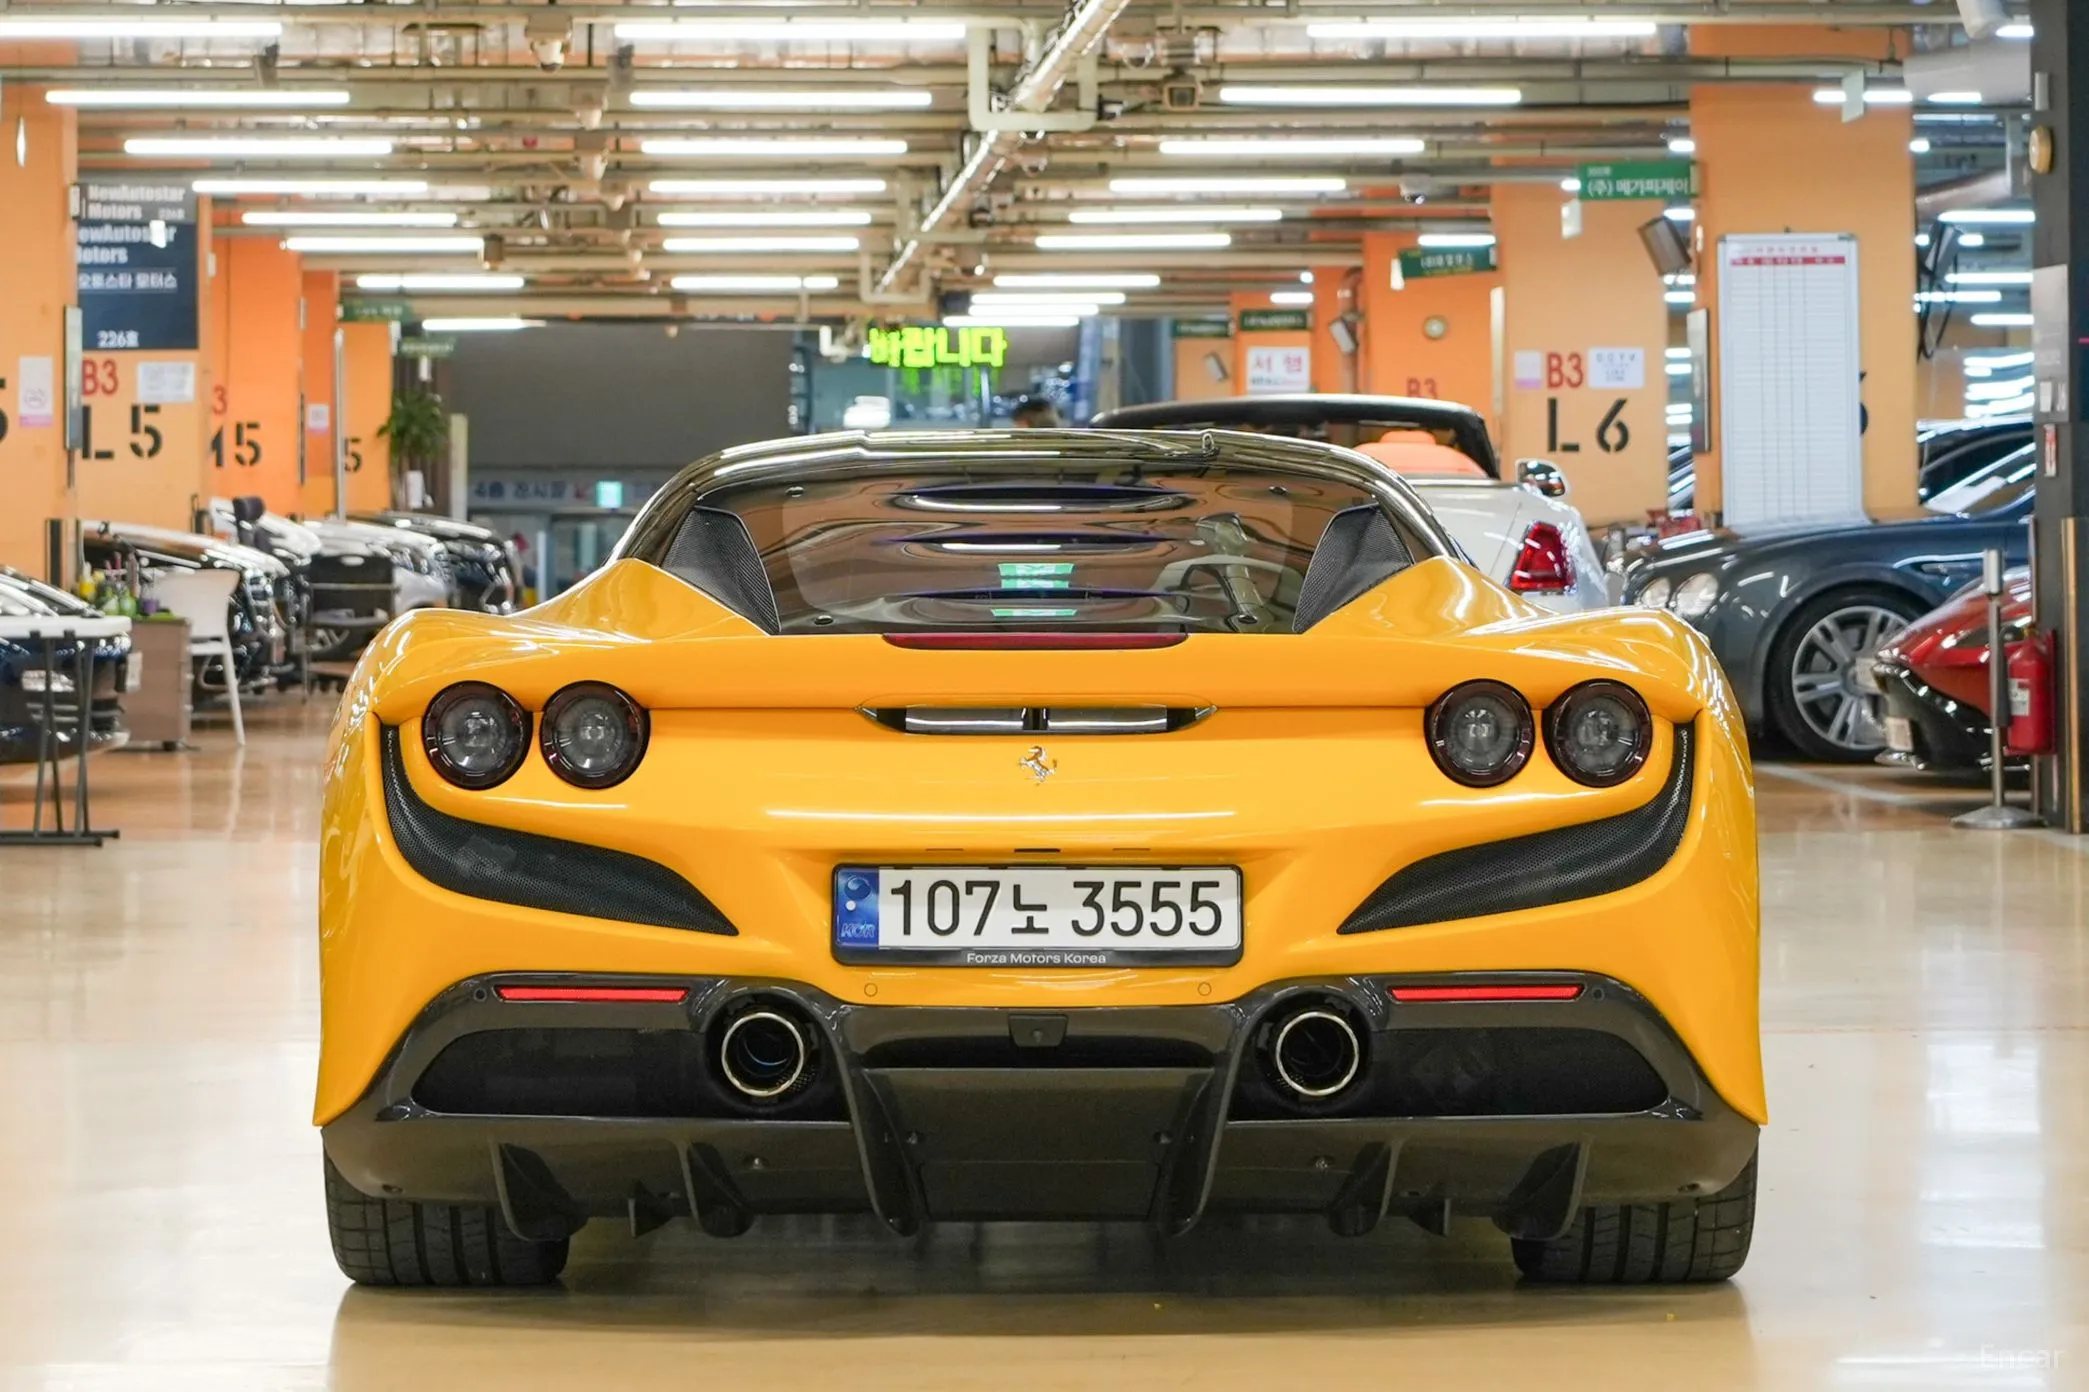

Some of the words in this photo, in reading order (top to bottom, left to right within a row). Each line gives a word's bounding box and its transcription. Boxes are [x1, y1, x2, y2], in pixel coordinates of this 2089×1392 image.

[78, 246, 128, 264] otors
[869, 327, 1008, 368] 바랍니다
[82, 358, 119, 396] B3
[1547, 352, 1584, 389] B3
[212, 384, 228, 415] 3
[891, 880, 1049, 936] 107노
[1071, 881, 1222, 936] 3555
[966, 952, 1007, 964] Forza
[1010, 952, 1061, 964] Motors
[1064, 952, 1106, 964] Korea
